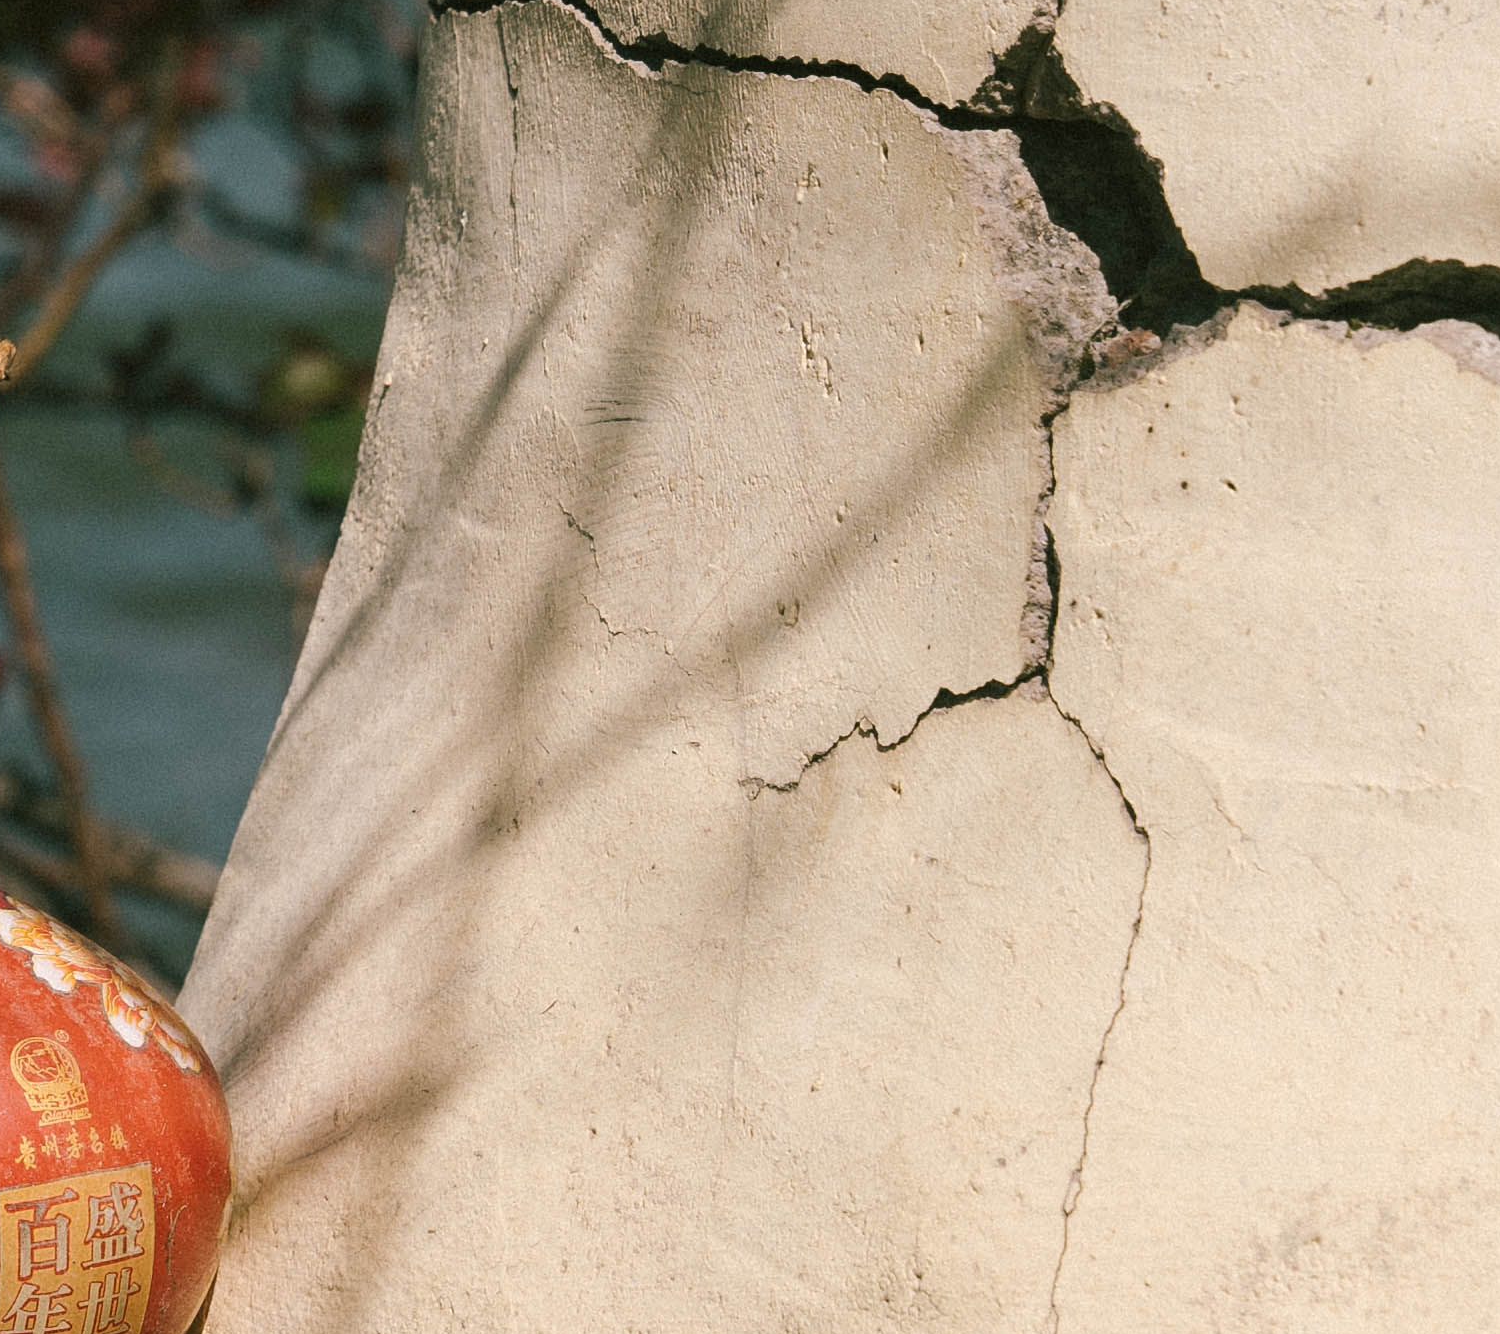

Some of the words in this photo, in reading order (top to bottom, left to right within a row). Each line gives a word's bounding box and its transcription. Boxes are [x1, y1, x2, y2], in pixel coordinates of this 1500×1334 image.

[15, 1125, 128, 1170] 贵州茅台镇
